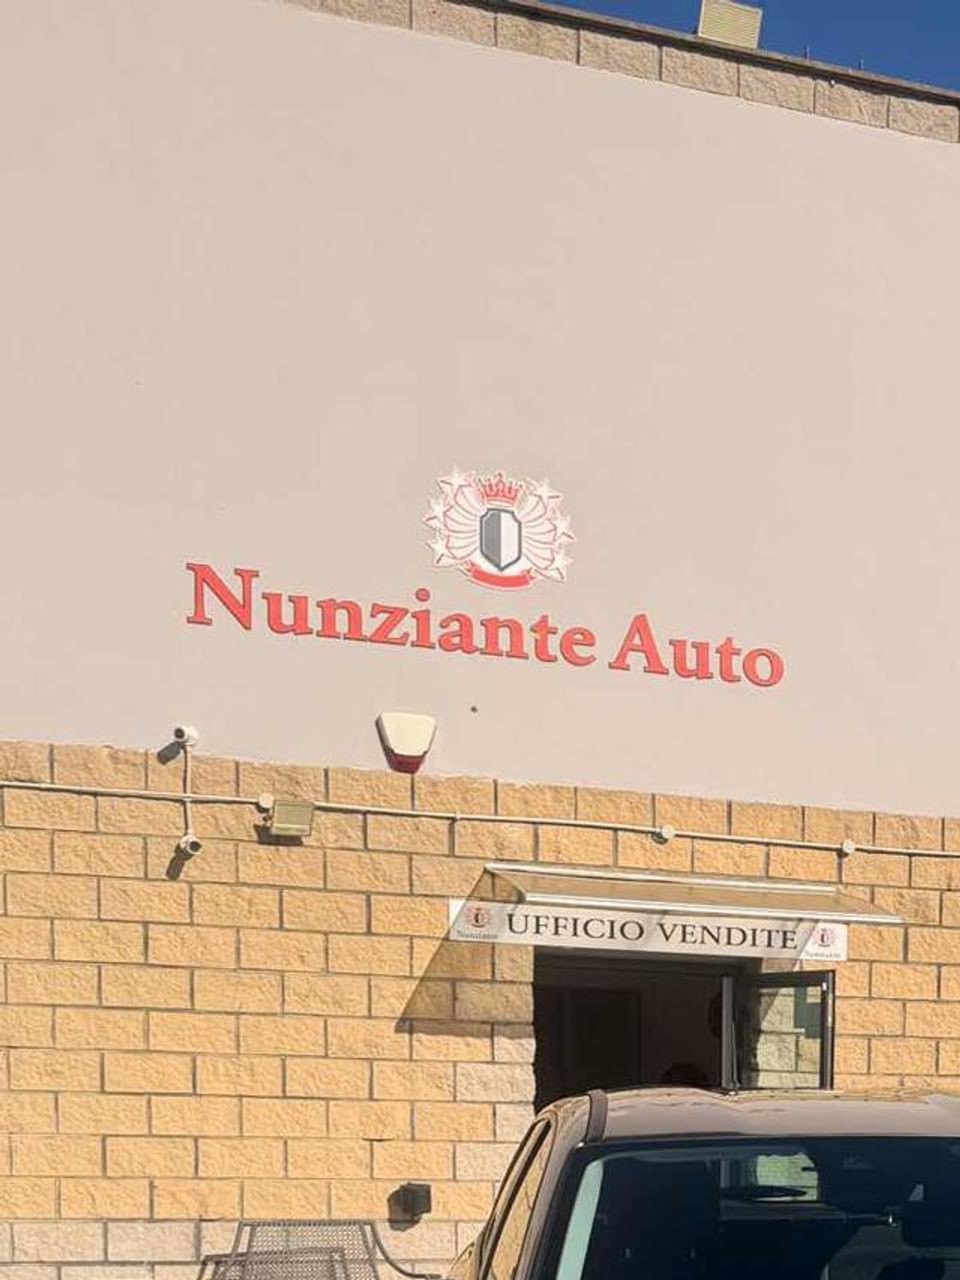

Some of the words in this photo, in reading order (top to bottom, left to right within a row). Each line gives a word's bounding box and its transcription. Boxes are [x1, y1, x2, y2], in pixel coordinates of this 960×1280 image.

[186, 561, 598, 666] Nunziante
[608, 613, 785, 688] Auto
[506, 912, 646, 942] UFFICIO
[657, 922, 800, 951] VENDITE
